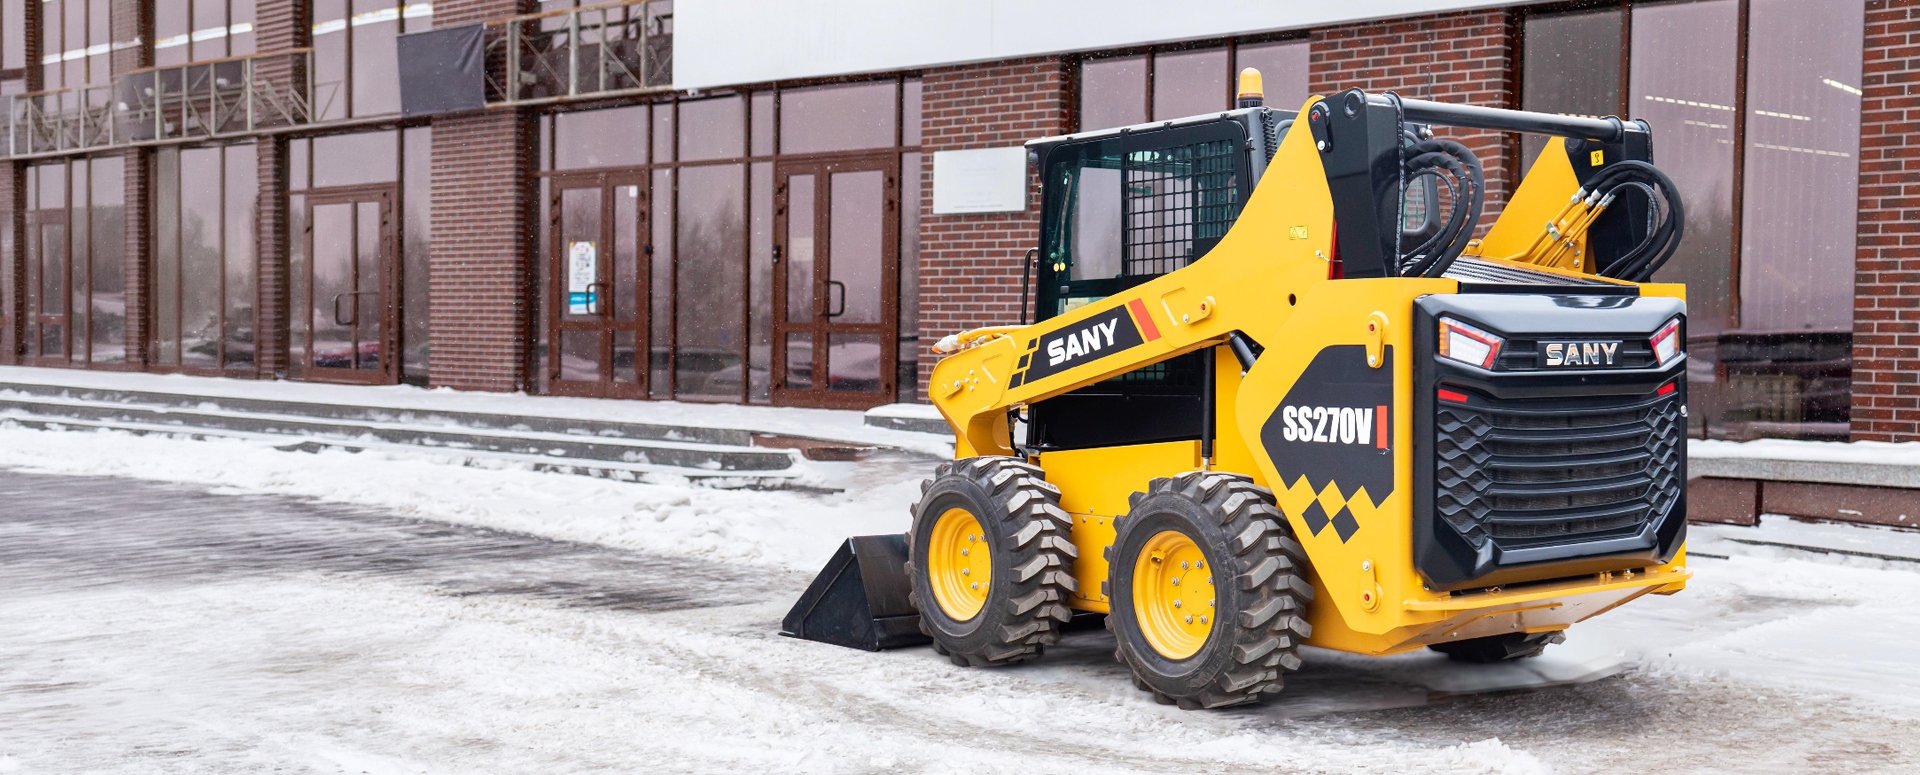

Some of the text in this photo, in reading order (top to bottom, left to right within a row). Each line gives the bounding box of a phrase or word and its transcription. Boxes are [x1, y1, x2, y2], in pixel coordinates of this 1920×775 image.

[1047, 318, 1118, 367] SANY
[1546, 342, 1618, 366] SANY
[1283, 405, 1373, 445] SS270V
